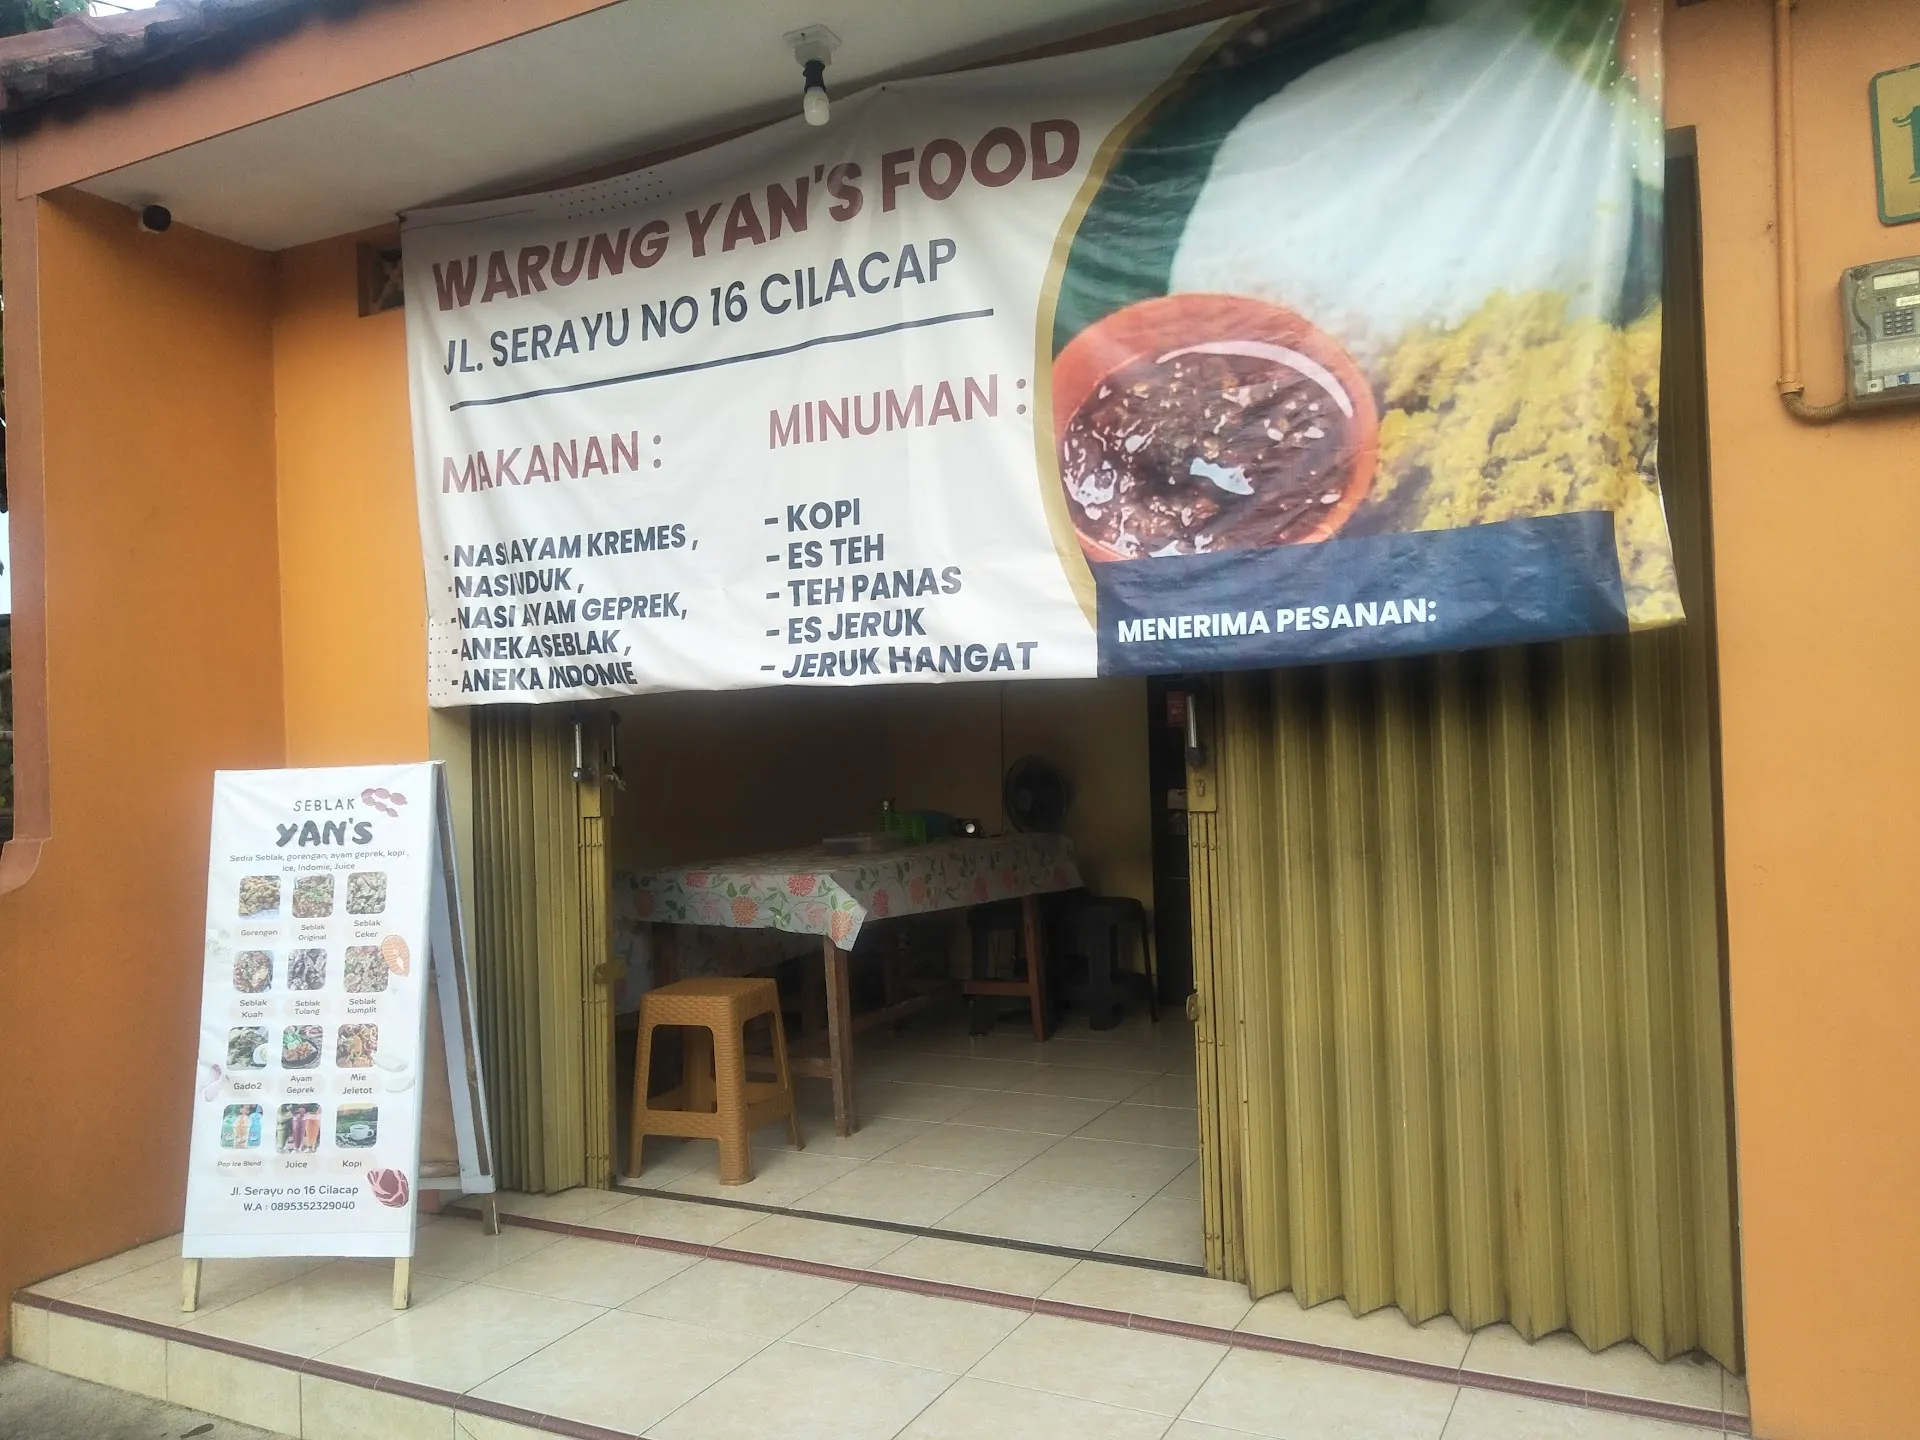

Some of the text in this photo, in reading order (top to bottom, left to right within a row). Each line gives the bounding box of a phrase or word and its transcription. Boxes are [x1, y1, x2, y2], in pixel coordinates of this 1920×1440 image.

[432, 118, 1081, 311] WARUNG YAN'S FOOD
[443, 237, 957, 375] JL. SERAYU NO 16 CILACAP
[769, 374, 999, 450] MINUMAN
[442, 430, 640, 494] MAKANAN
[787, 498, 861, 532] KOPI
[510, 535, 582, 564] AYAM
[587, 523, 686, 558] KREMES
[788, 541, 823, 569] ES
[829, 534, 884, 566] TEH
[788, 576, 844, 607] TEH
[852, 566, 962, 602] PANAS
[457, 605, 515, 630] NASI
[520, 599, 576, 627] AYAM
[581, 592, 688, 621] GEPREK,
[788, 616, 822, 644] ES
[827, 607, 926, 641] JERUK
[1117, 597, 1437, 643] MENERIMA PESANAN:
[460, 636, 543, 661] ANEKA
[541, 629, 620, 658] SEBLAK
[782, 647, 881, 679] JERUK
[888, 641, 1039, 674] HANGAT
[461, 667, 544, 692] ANEKA
[548, 661, 638, 689] INDOMIE
[293, 798, 355, 812] SEBLAK
[276, 817, 373, 847] YAN'S
[229, 854, 253, 862] Sedia
[255, 853, 285, 862] Seblak,
[286, 852, 329, 862] gorengan,
[330, 852, 353, 861] ayam
[354, 850, 385, 860] geprek,
[282, 864, 296, 873] ice,
[333, 862, 356, 871] Juice
[301, 923, 326, 931] Seblak
[353, 919, 381, 927] Seblak
[240, 929, 278, 938] Gorengan
[298, 933, 327, 942] Original
[355, 930, 378, 938] Ceker
[239, 999, 267, 1007] Seblak
[348, 998, 376, 1006] Seblak
[241, 1010, 264, 1018] Kuah
[294, 1007, 321, 1016] Tulang
[347, 1006, 377, 1015] kumplit
[290, 1074, 313, 1083] Ayam
[350, 1073, 367, 1081] Mie
[233, 1081, 263, 1091] Gado2
[286, 1085, 315, 1095] Geprek
[342, 1086, 373, 1095] Jeletot
[285, 1160, 308, 1169] Juice
[342, 1159, 362, 1169] Kopi
[230, 1185, 359, 1197] Jl. Serayu no 16 Cilacap
[243, 1202, 262, 1211] W.A
[270, 1201, 356, 1211] 0895352329040
